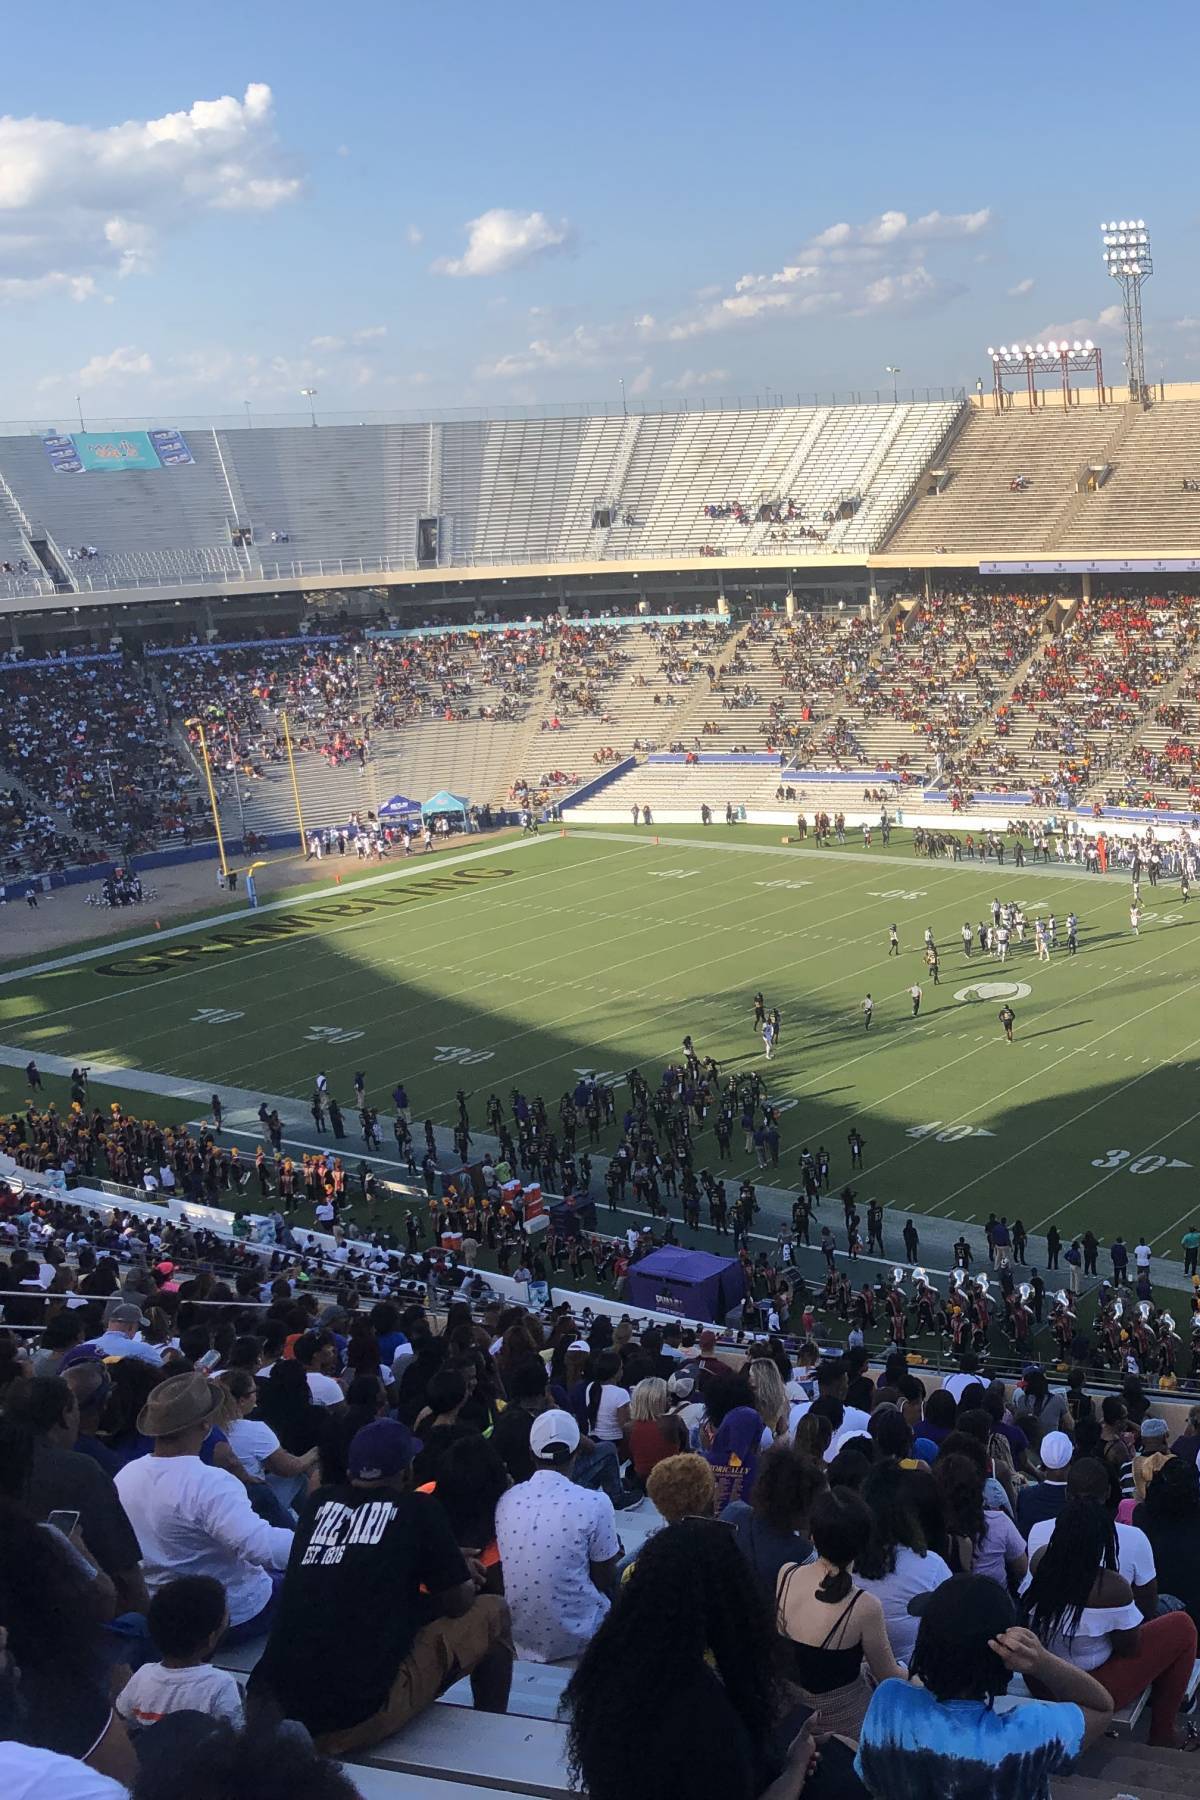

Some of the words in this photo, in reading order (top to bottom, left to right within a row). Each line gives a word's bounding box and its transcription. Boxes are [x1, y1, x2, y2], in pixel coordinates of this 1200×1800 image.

[94, 868, 517, 977] GRAMBLING
[189, 1008, 245, 1024] 10
[303, 1027, 365, 1044] 20
[433, 1047, 495, 1065] 30
[905, 1121, 973, 1143] 40
[1091, 1150, 1167, 1174] 30
[301, 1545, 321, 1565] EST.
